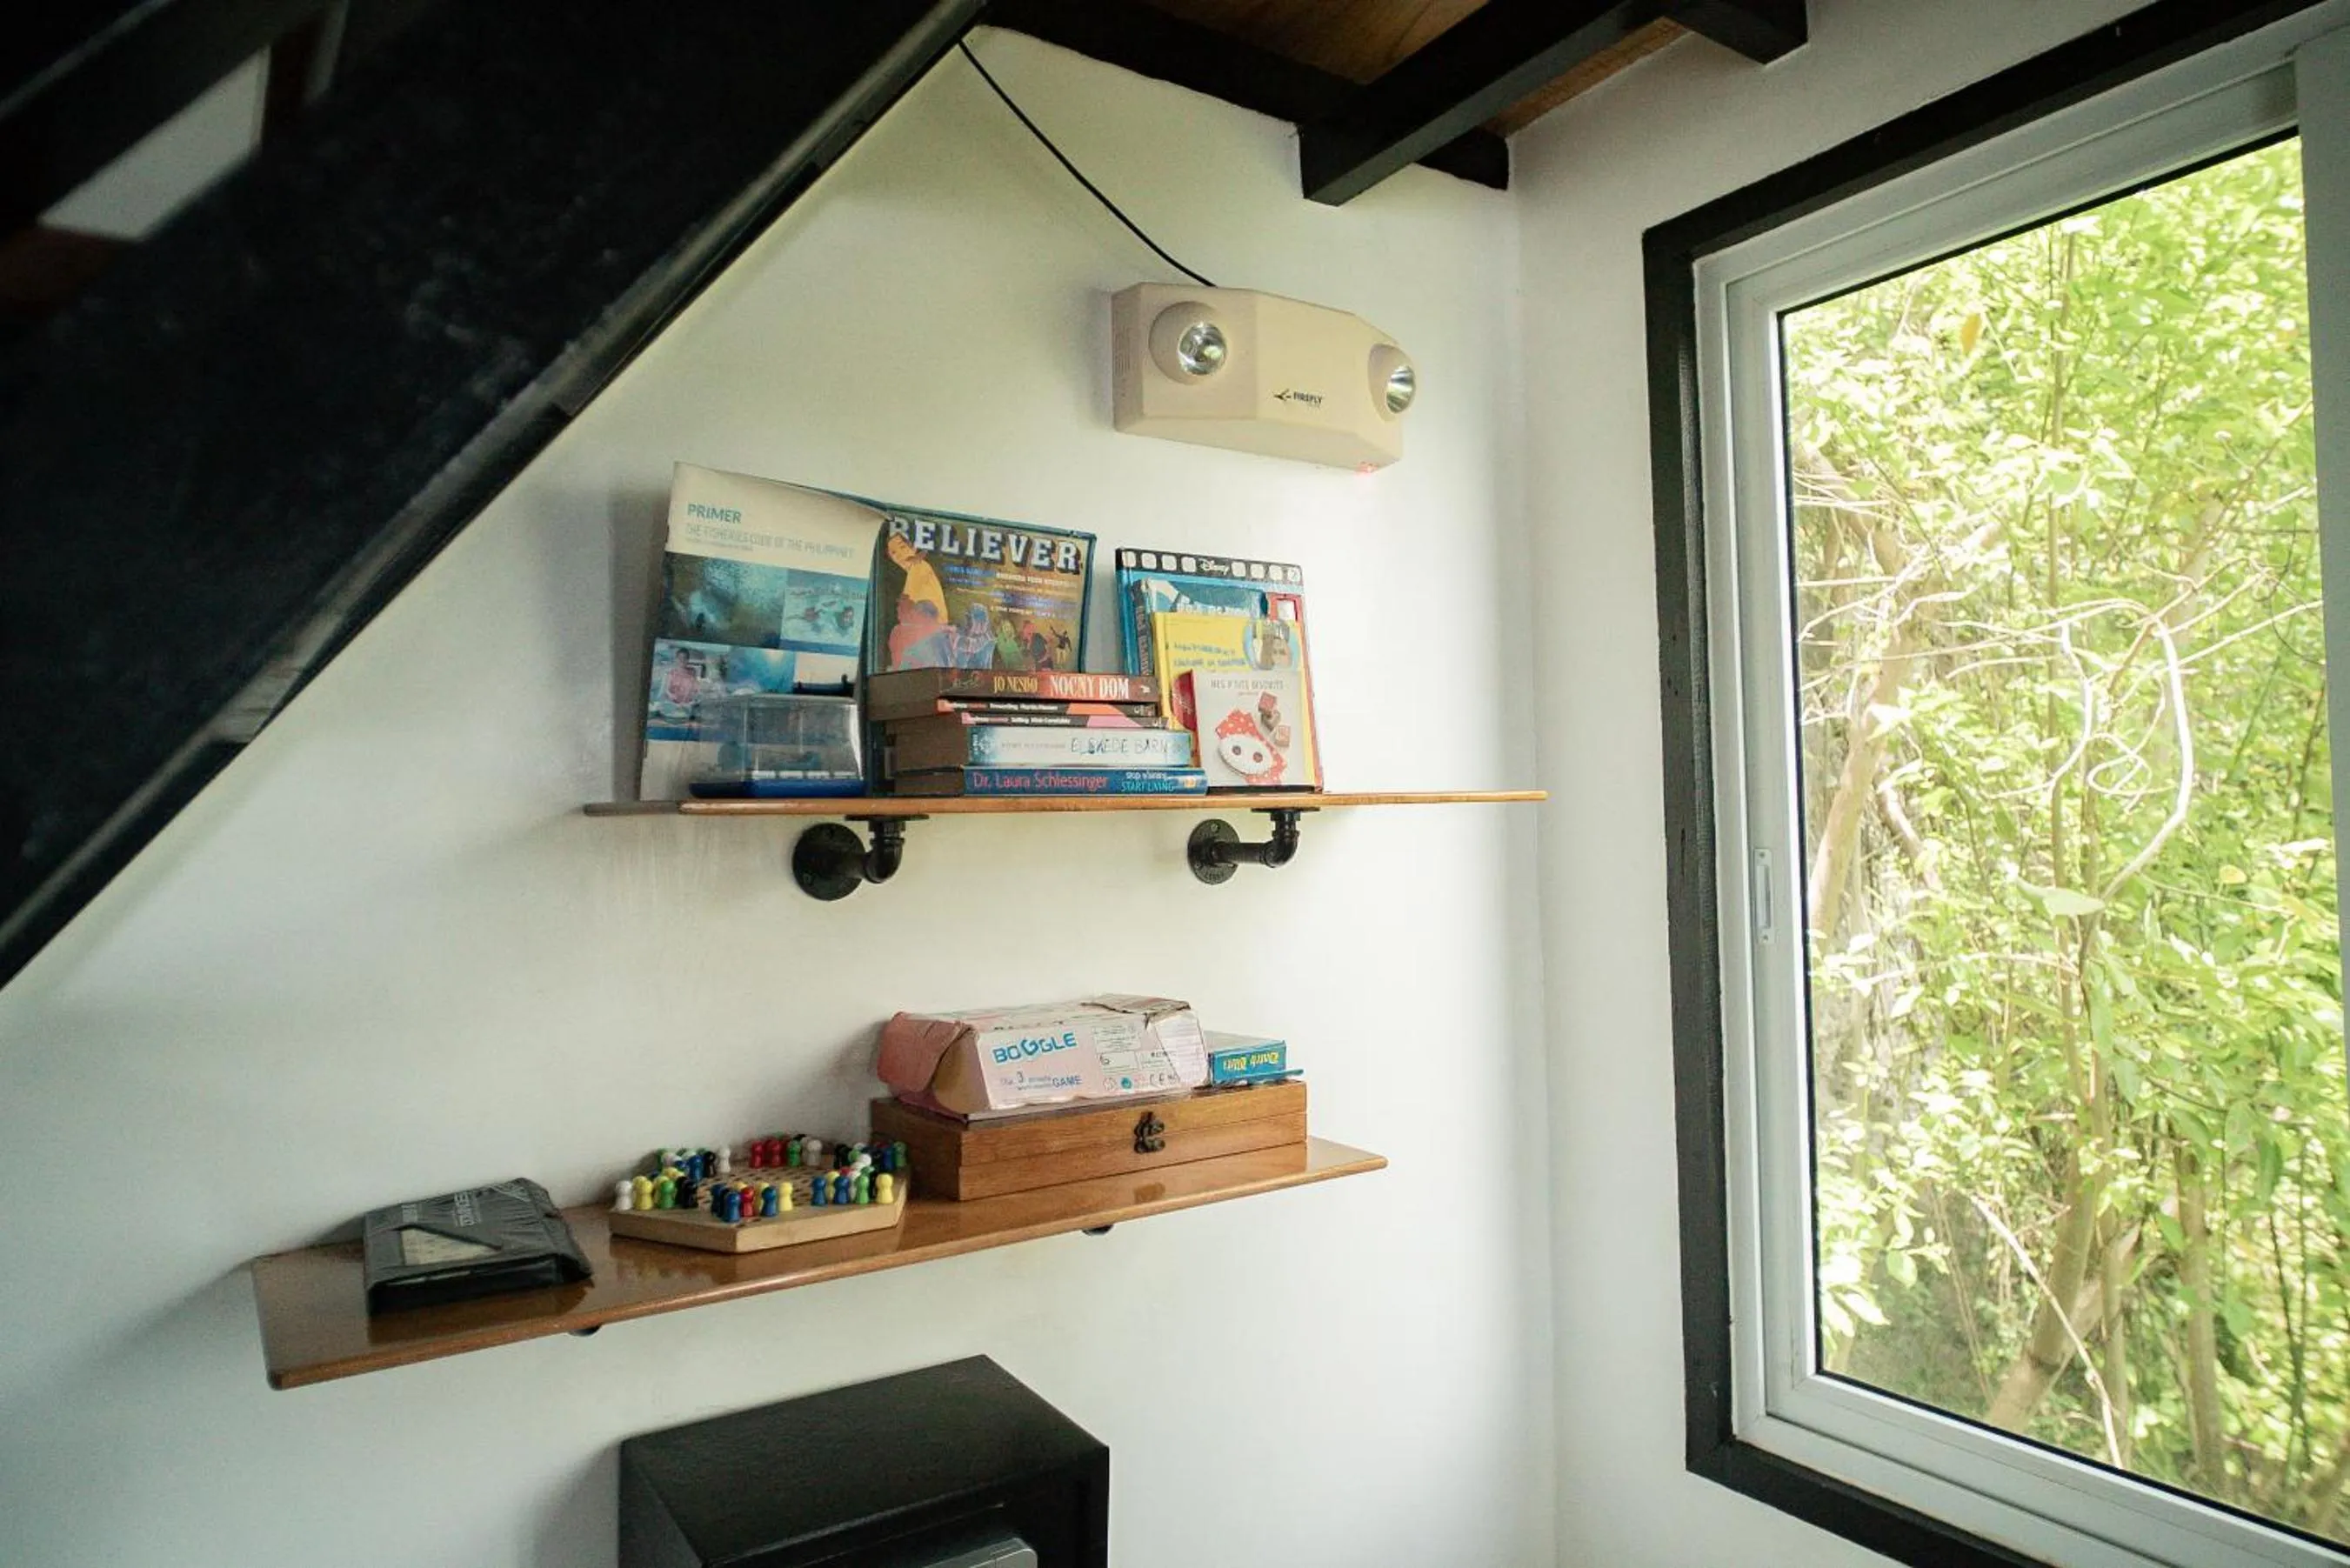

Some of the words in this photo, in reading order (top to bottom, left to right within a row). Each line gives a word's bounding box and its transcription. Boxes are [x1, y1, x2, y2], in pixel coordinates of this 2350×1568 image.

[687, 503, 742, 524] PRIMER
[1198, 557, 1230, 576] Disney
[993, 675, 1006, 694] JO
[1050, 674, 1095, 697] NOCNY
[1098, 676, 1130, 699] DOM
[972, 771, 991, 788] Dr.
[995, 771, 1031, 788] Laura
[1033, 770, 1108, 792] Schlessinger
[991, 1031, 1078, 1064] BOGGLE
[1051, 1075, 1083, 1088] GAME
